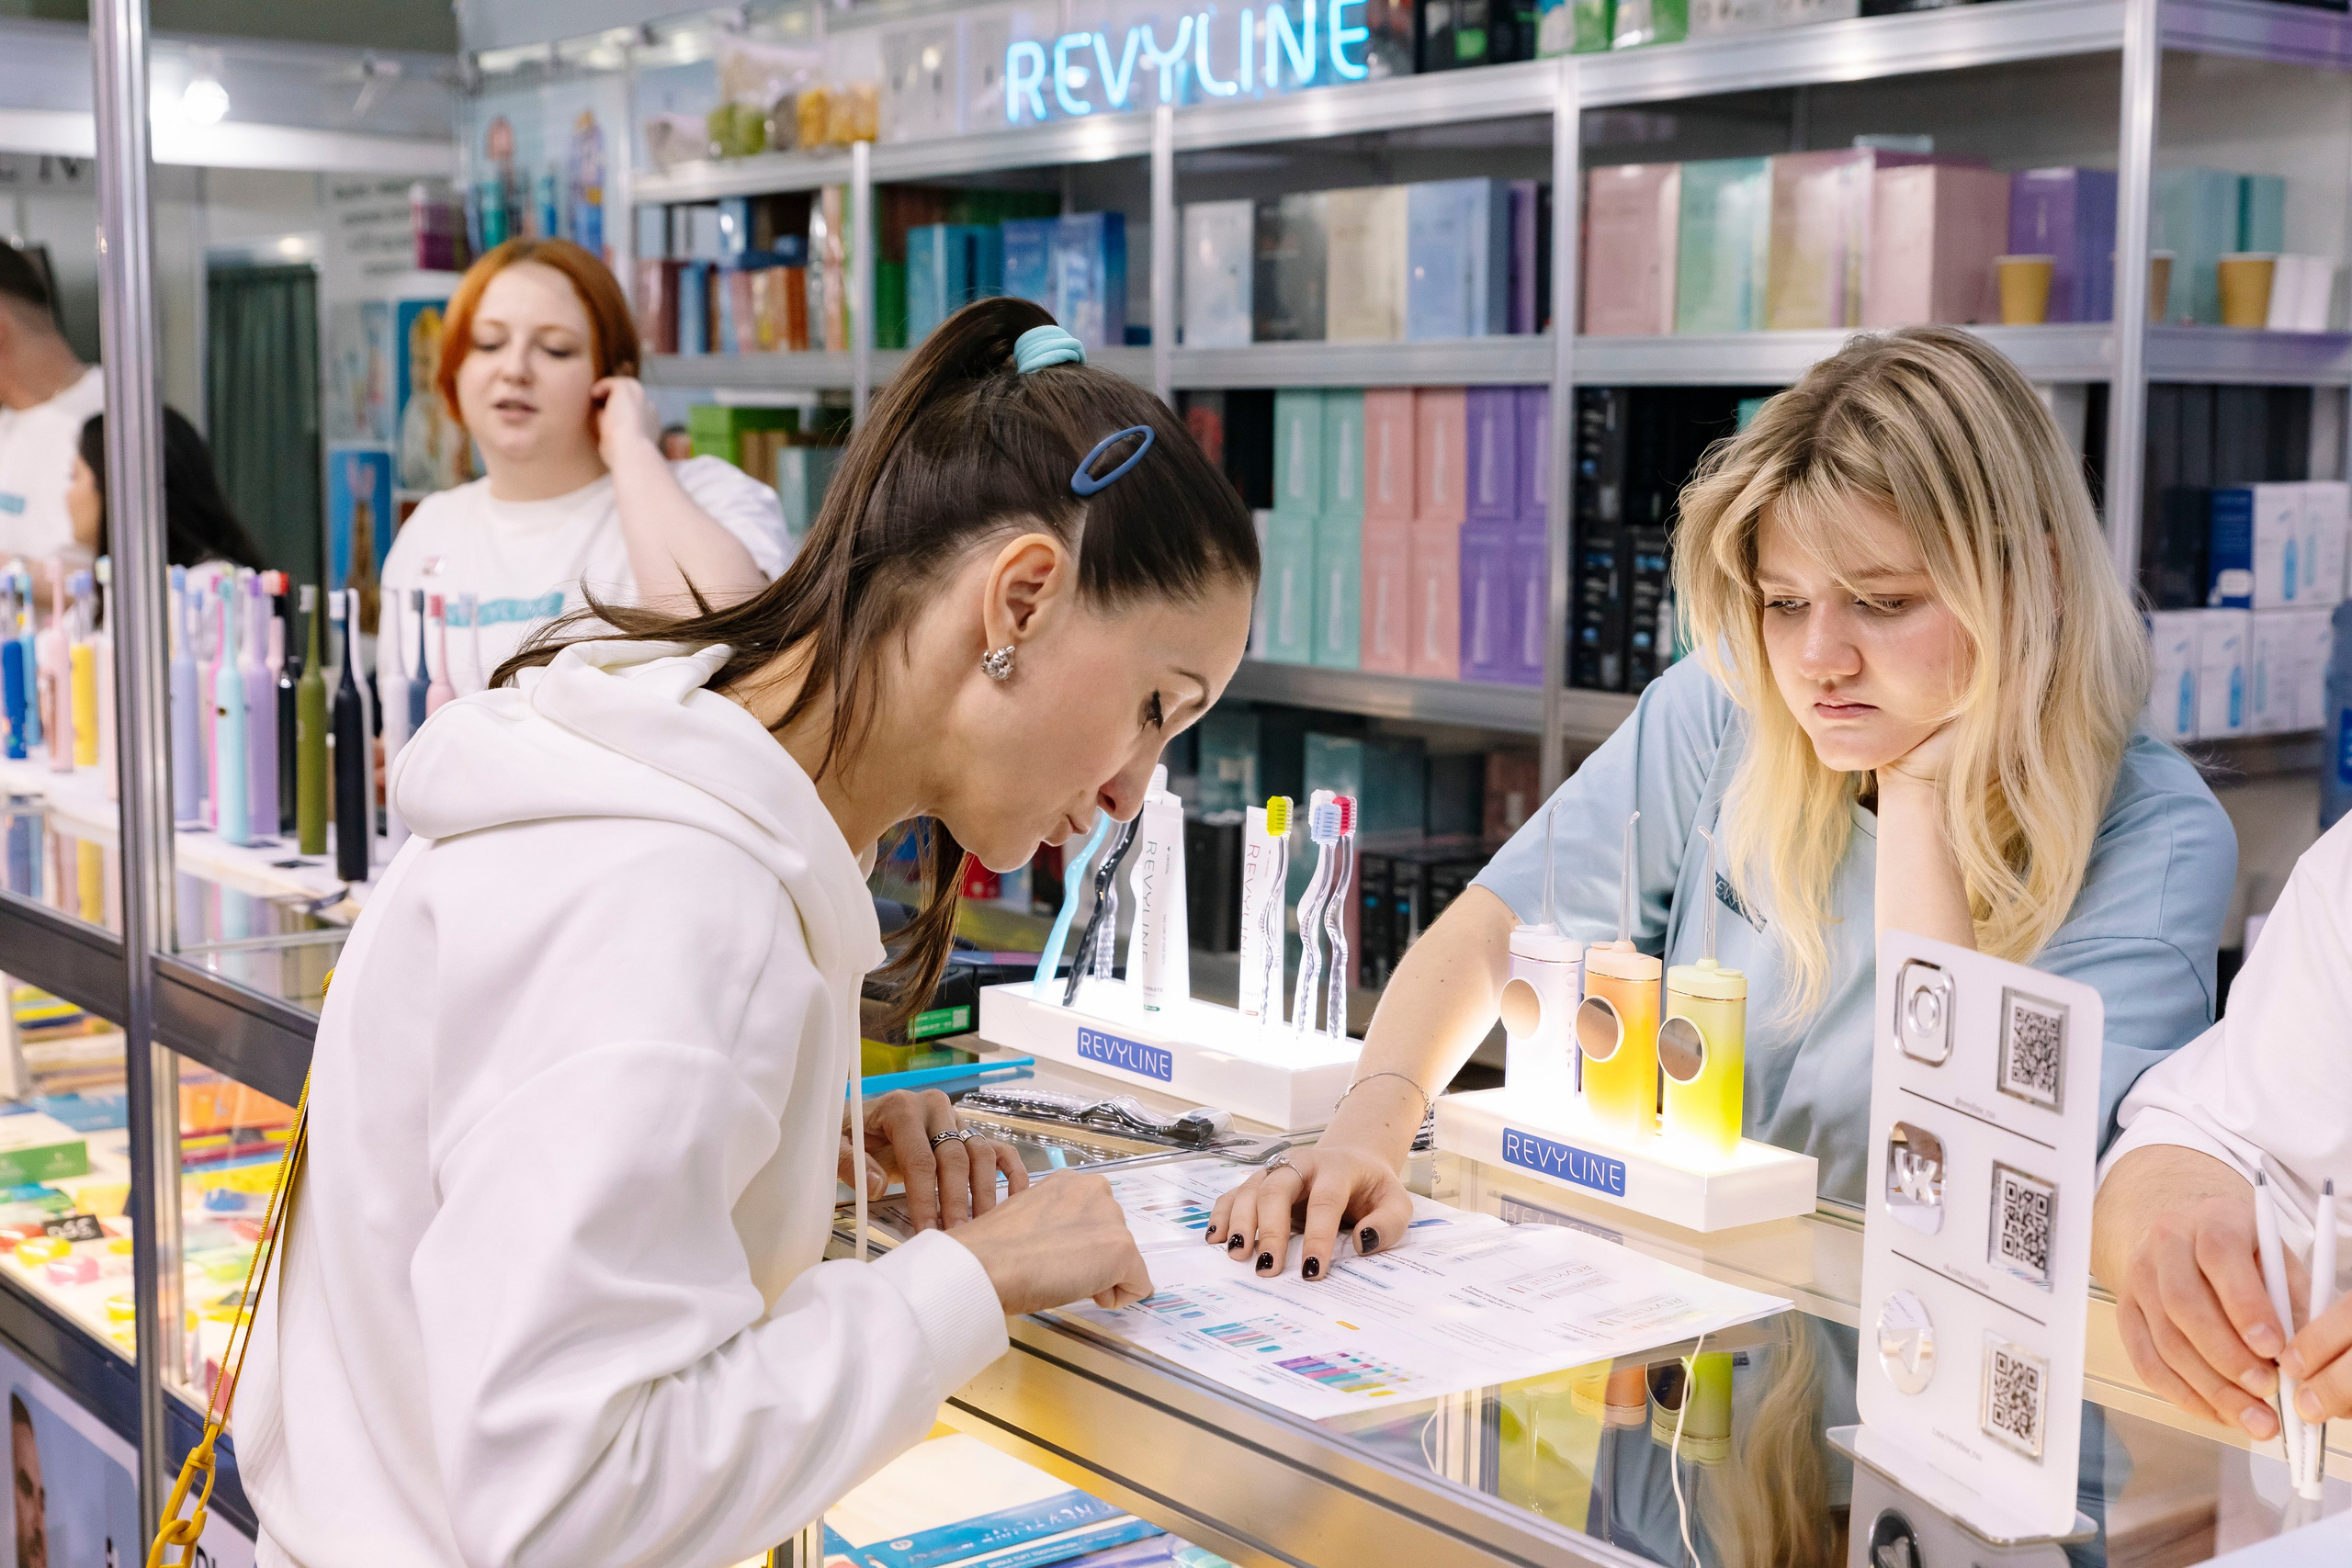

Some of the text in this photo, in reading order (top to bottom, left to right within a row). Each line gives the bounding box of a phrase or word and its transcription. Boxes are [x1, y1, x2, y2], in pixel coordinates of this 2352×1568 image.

[1006, 0, 1369, 121] REVYLINE
[1080, 1031, 1170, 1077] REVYLINE
[1507, 1133, 1622, 1191] REVYLINE
